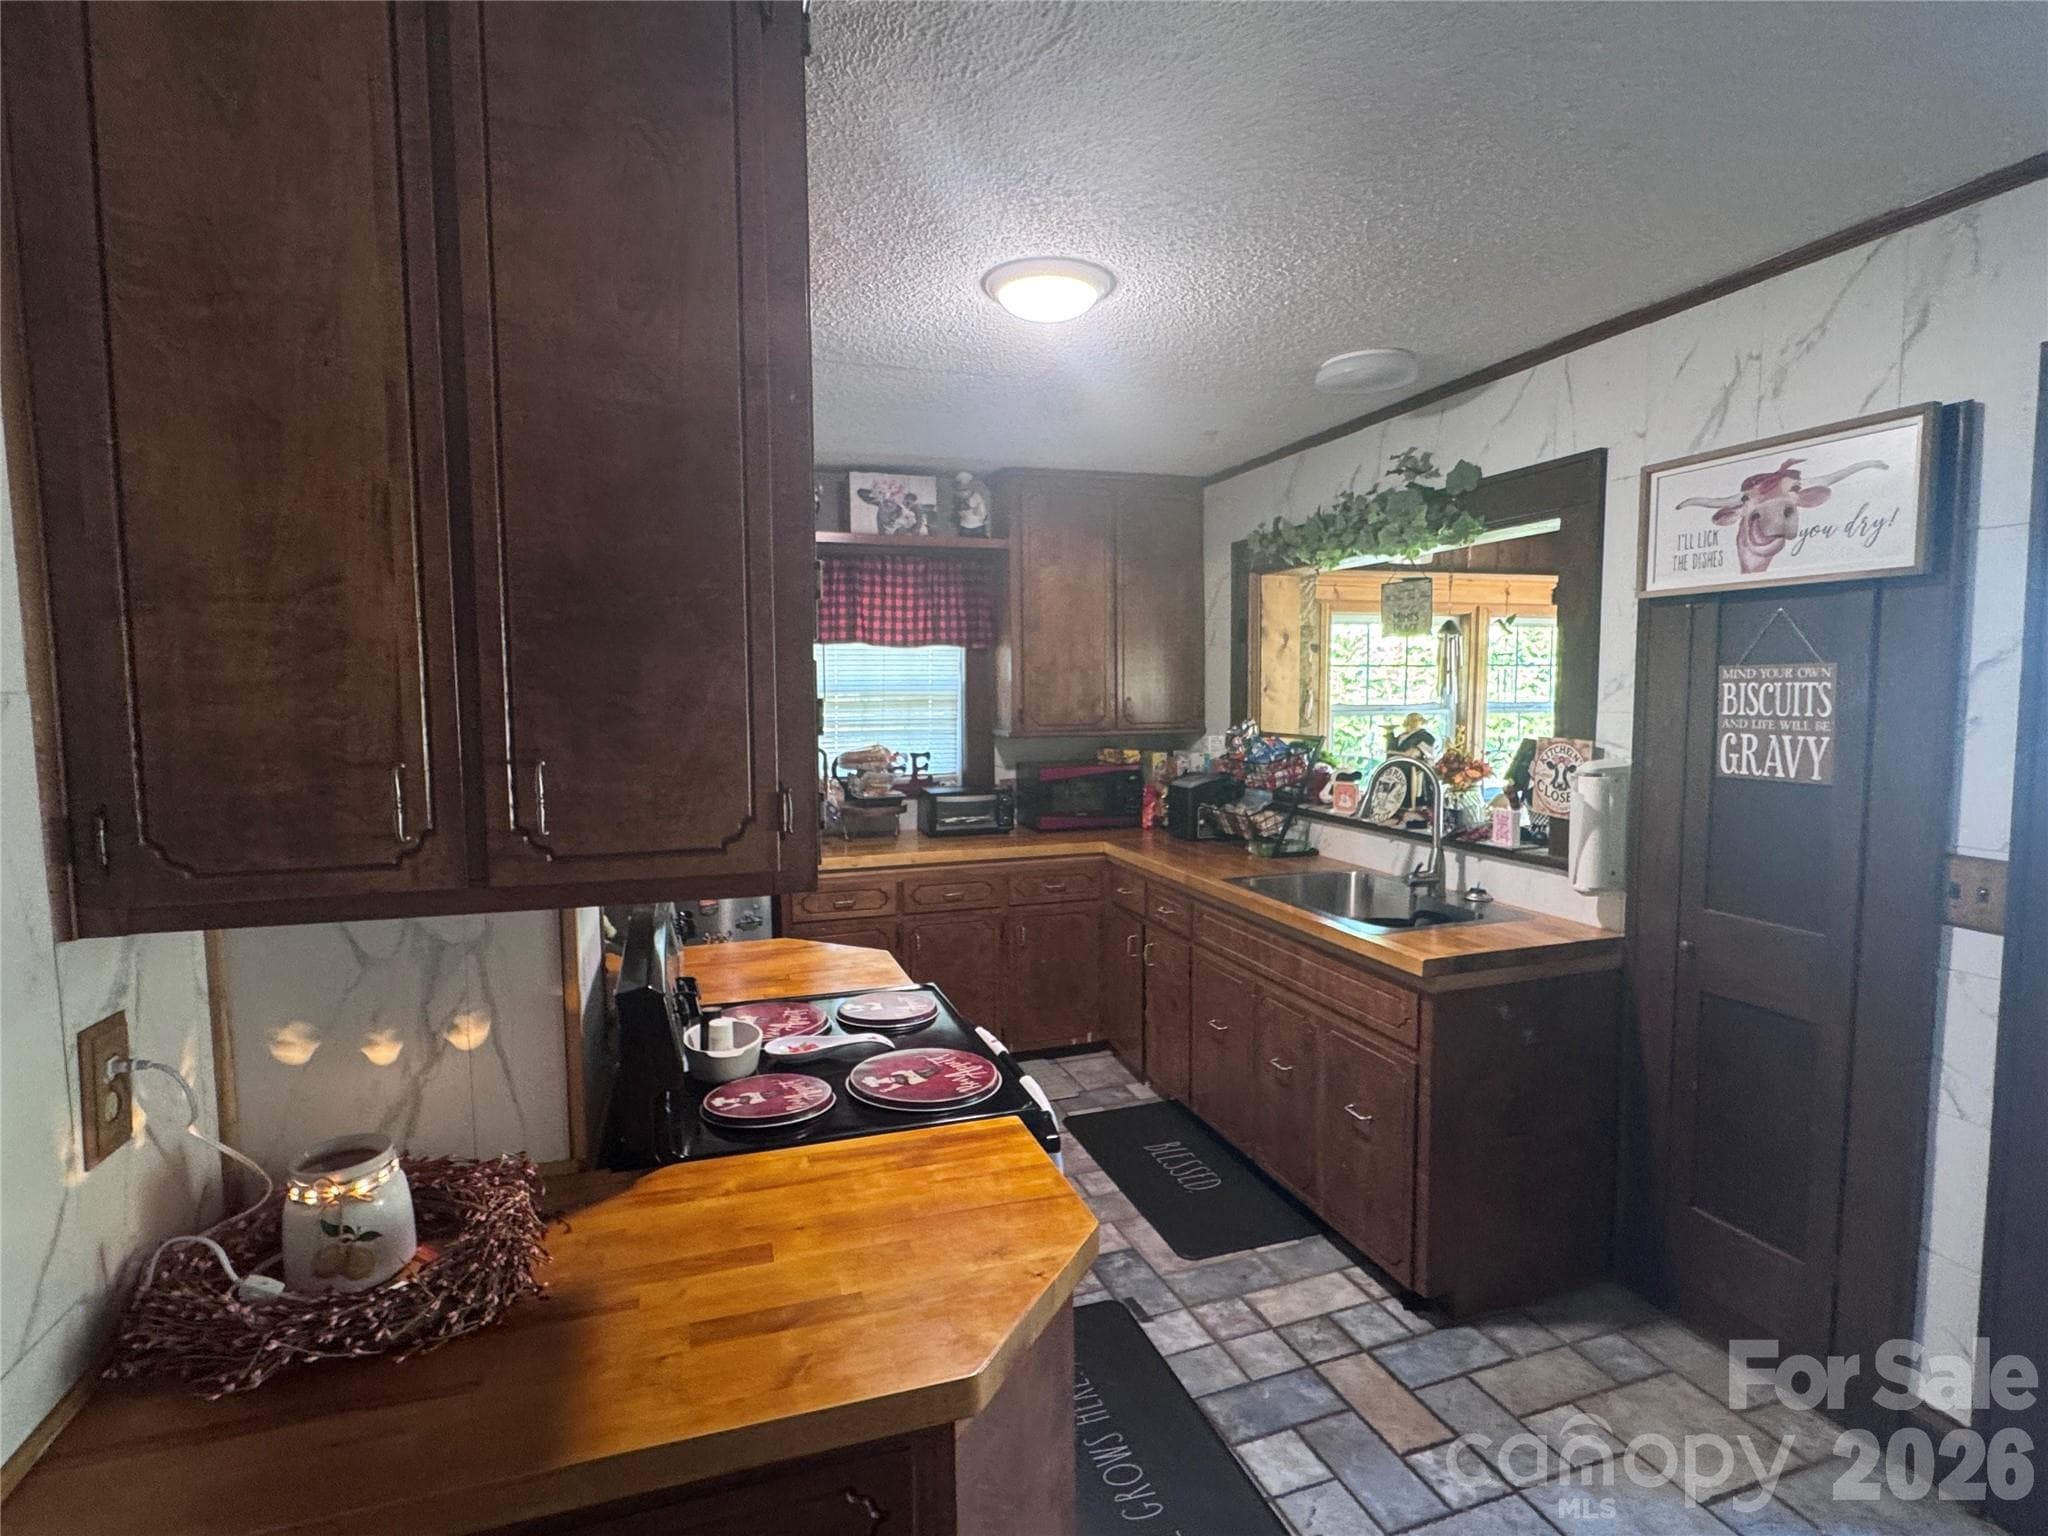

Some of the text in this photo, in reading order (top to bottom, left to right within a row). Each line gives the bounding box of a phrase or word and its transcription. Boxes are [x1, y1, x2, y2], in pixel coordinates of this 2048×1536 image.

[1677, 530, 1719, 551] I'LL LICK
[1791, 502, 1899, 556] you dry!
[1672, 550, 1724, 571] THE DISHES
[1722, 667, 1832, 679] MIND YOUR OWN
[1721, 682, 1832, 717] BISCUITS
[1721, 719, 1832, 731] AND LIFE WILL BE
[1719, 732, 1830, 781] GRAVY
[1537, 779, 1570, 803] CLOSE
[1083, 1432, 1164, 1520] GROWS
